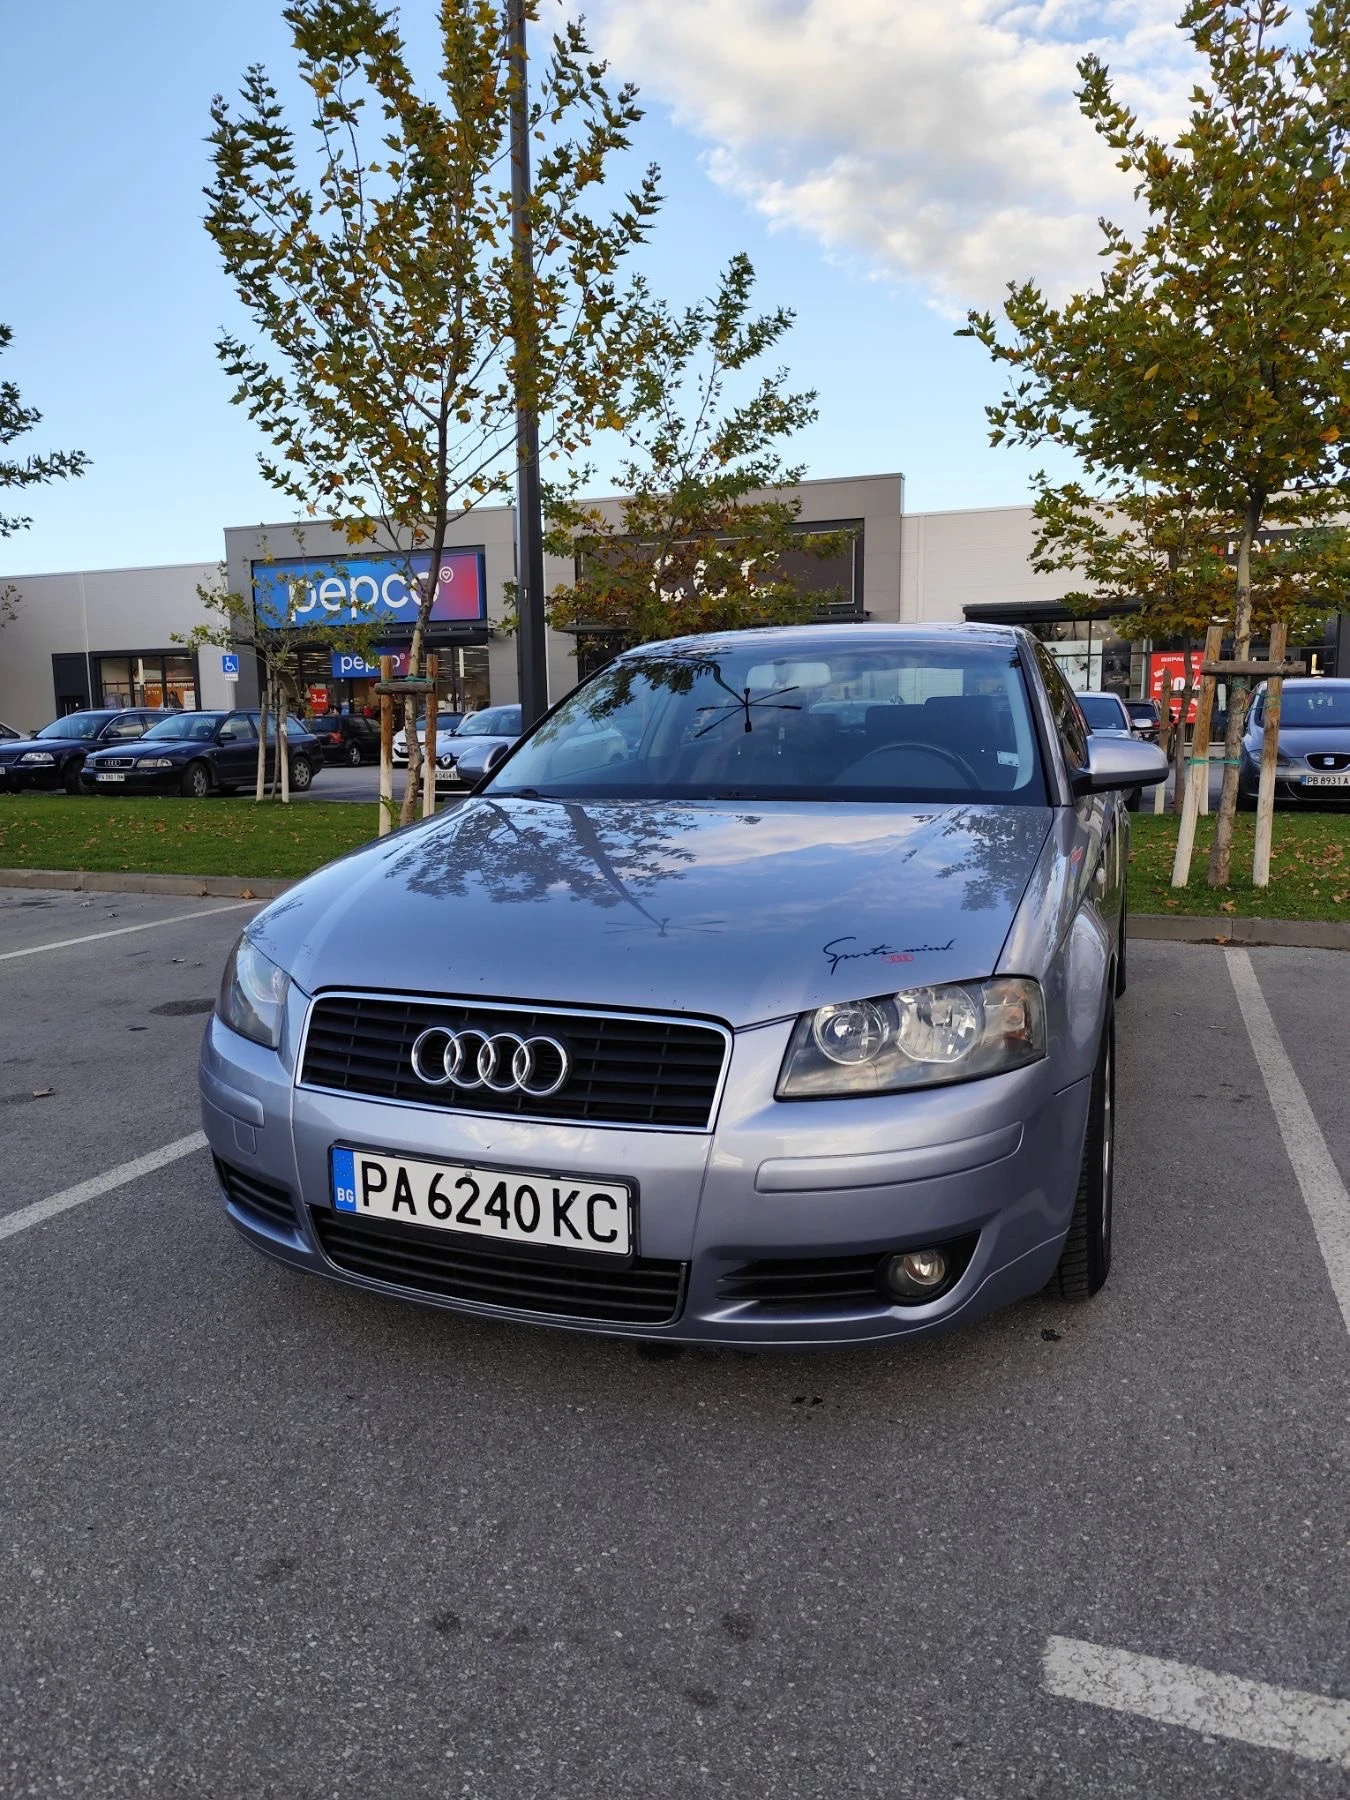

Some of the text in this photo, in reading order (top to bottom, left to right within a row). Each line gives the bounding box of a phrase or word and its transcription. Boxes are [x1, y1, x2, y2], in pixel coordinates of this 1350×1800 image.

[288, 571, 440, 622] pepco
[1306, 776, 1319, 785] PB
[1320, 776, 1341, 785] 8931
[337, 1187, 354, 1202] BG
[361, 1160, 618, 1244] PA 6240 KC
